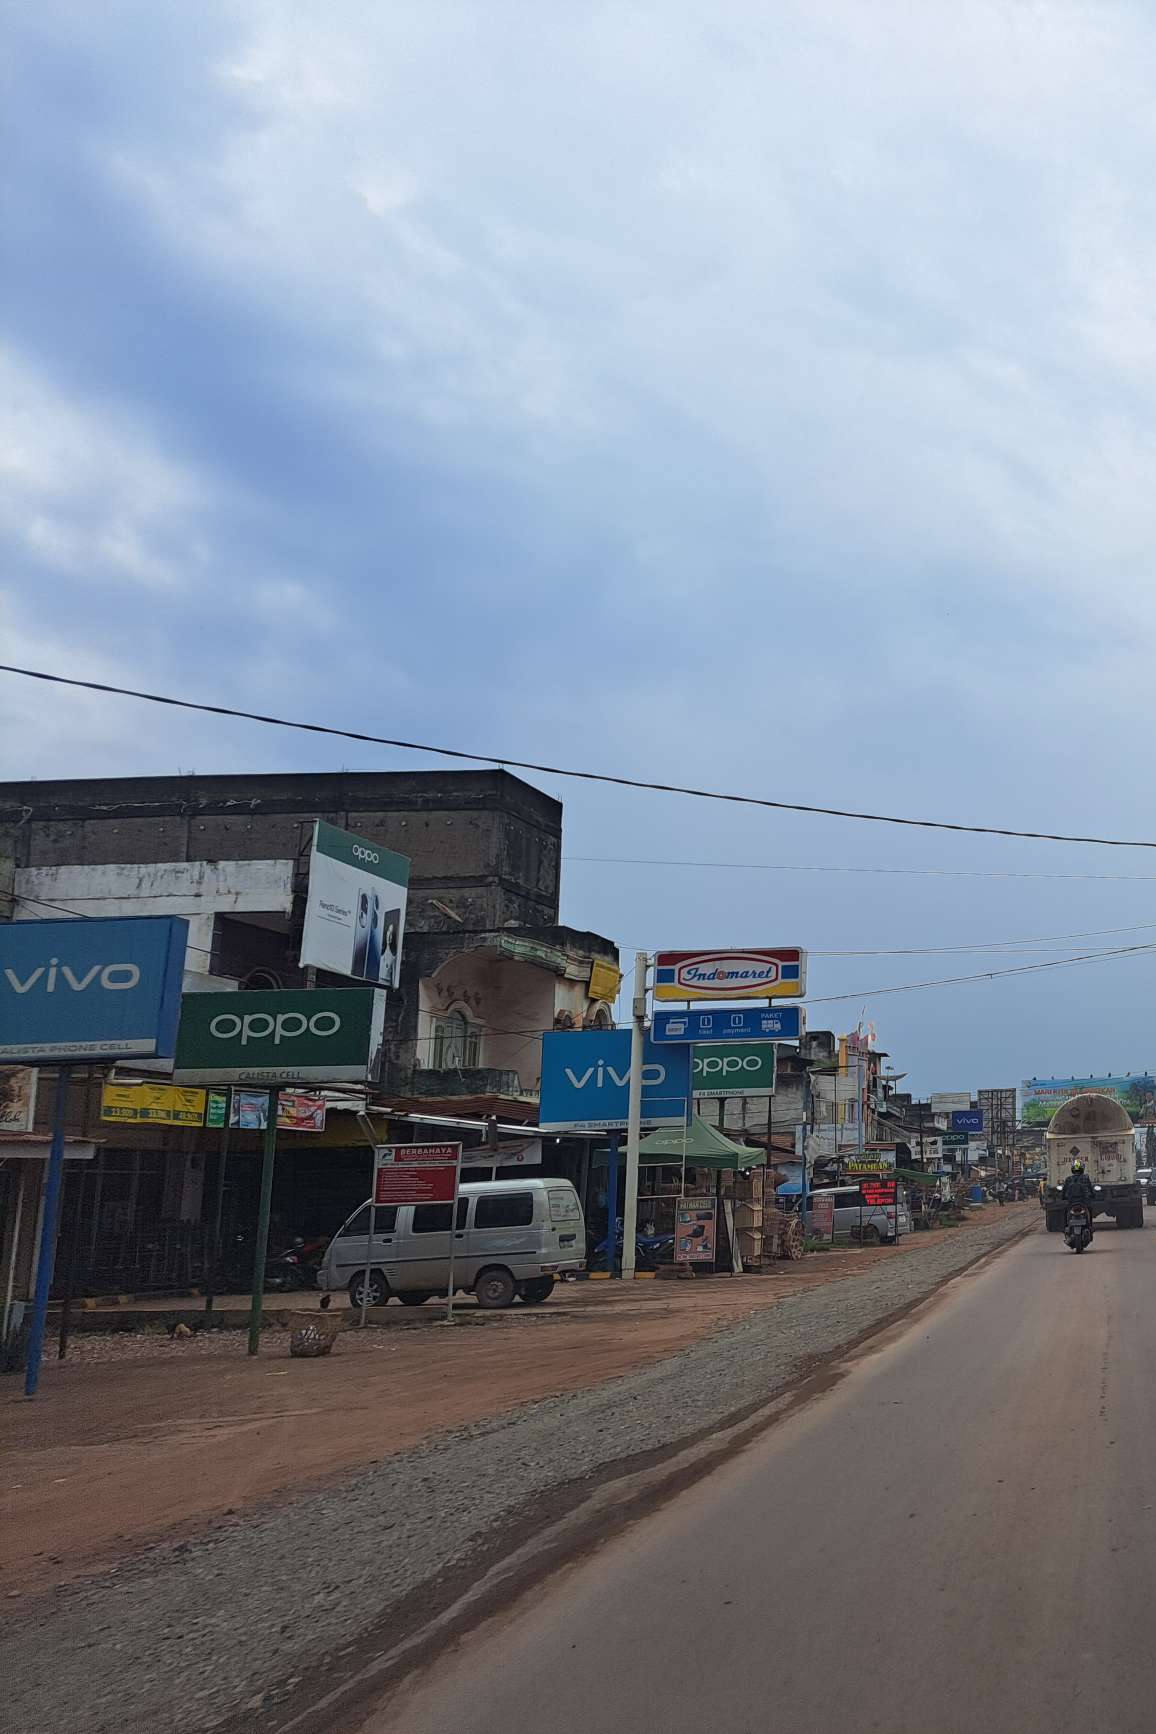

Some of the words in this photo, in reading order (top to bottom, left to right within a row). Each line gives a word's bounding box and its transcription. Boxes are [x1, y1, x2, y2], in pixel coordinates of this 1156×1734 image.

[352, 844, 380, 864] oppo
[4, 957, 141, 995] vivo
[682, 966, 774, 982] Indomaret
[760, 1011, 784, 1019] PAKET
[210, 1011, 342, 1045] oppo
[99, 1041, 133, 1052] CELL
[564, 1059, 667, 1090] vivo
[693, 1056, 763, 1077] oppo
[238, 1071, 277, 1081] CALISTA
[956, 1117, 979, 1125] vivo
[655, 1136, 695, 1146] oppo
